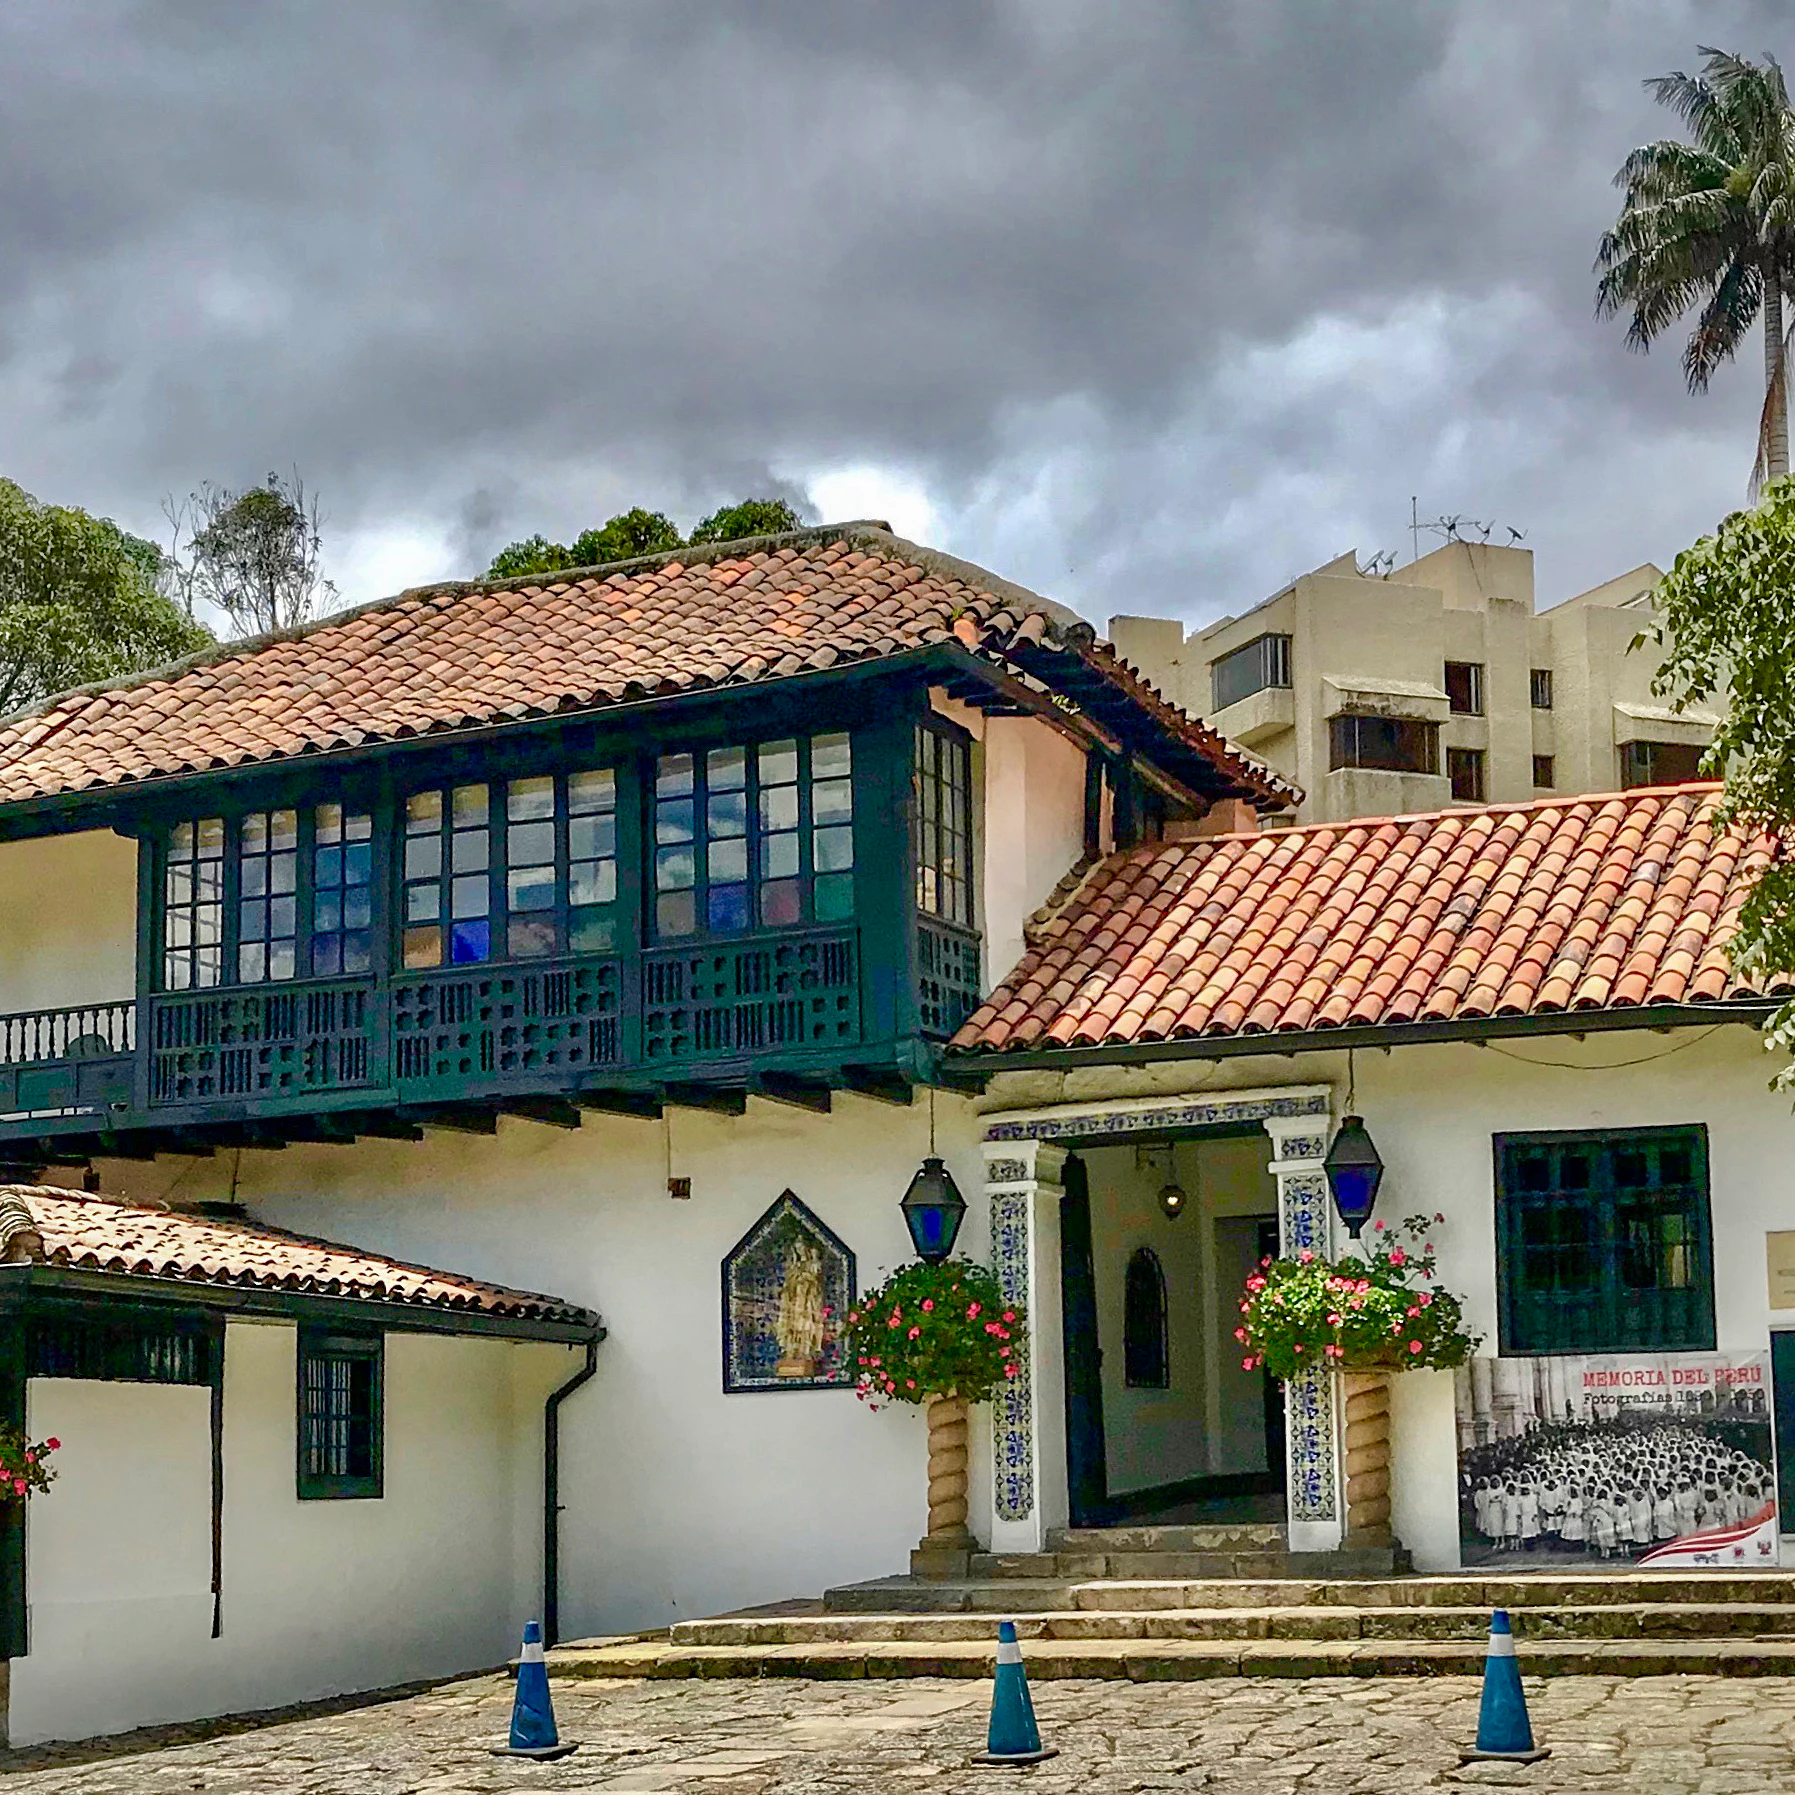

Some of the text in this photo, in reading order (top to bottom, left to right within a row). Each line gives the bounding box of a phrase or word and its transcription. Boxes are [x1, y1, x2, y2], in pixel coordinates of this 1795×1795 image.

[1583, 1364, 1761, 1387] MEMORIA DEL PERÚ
